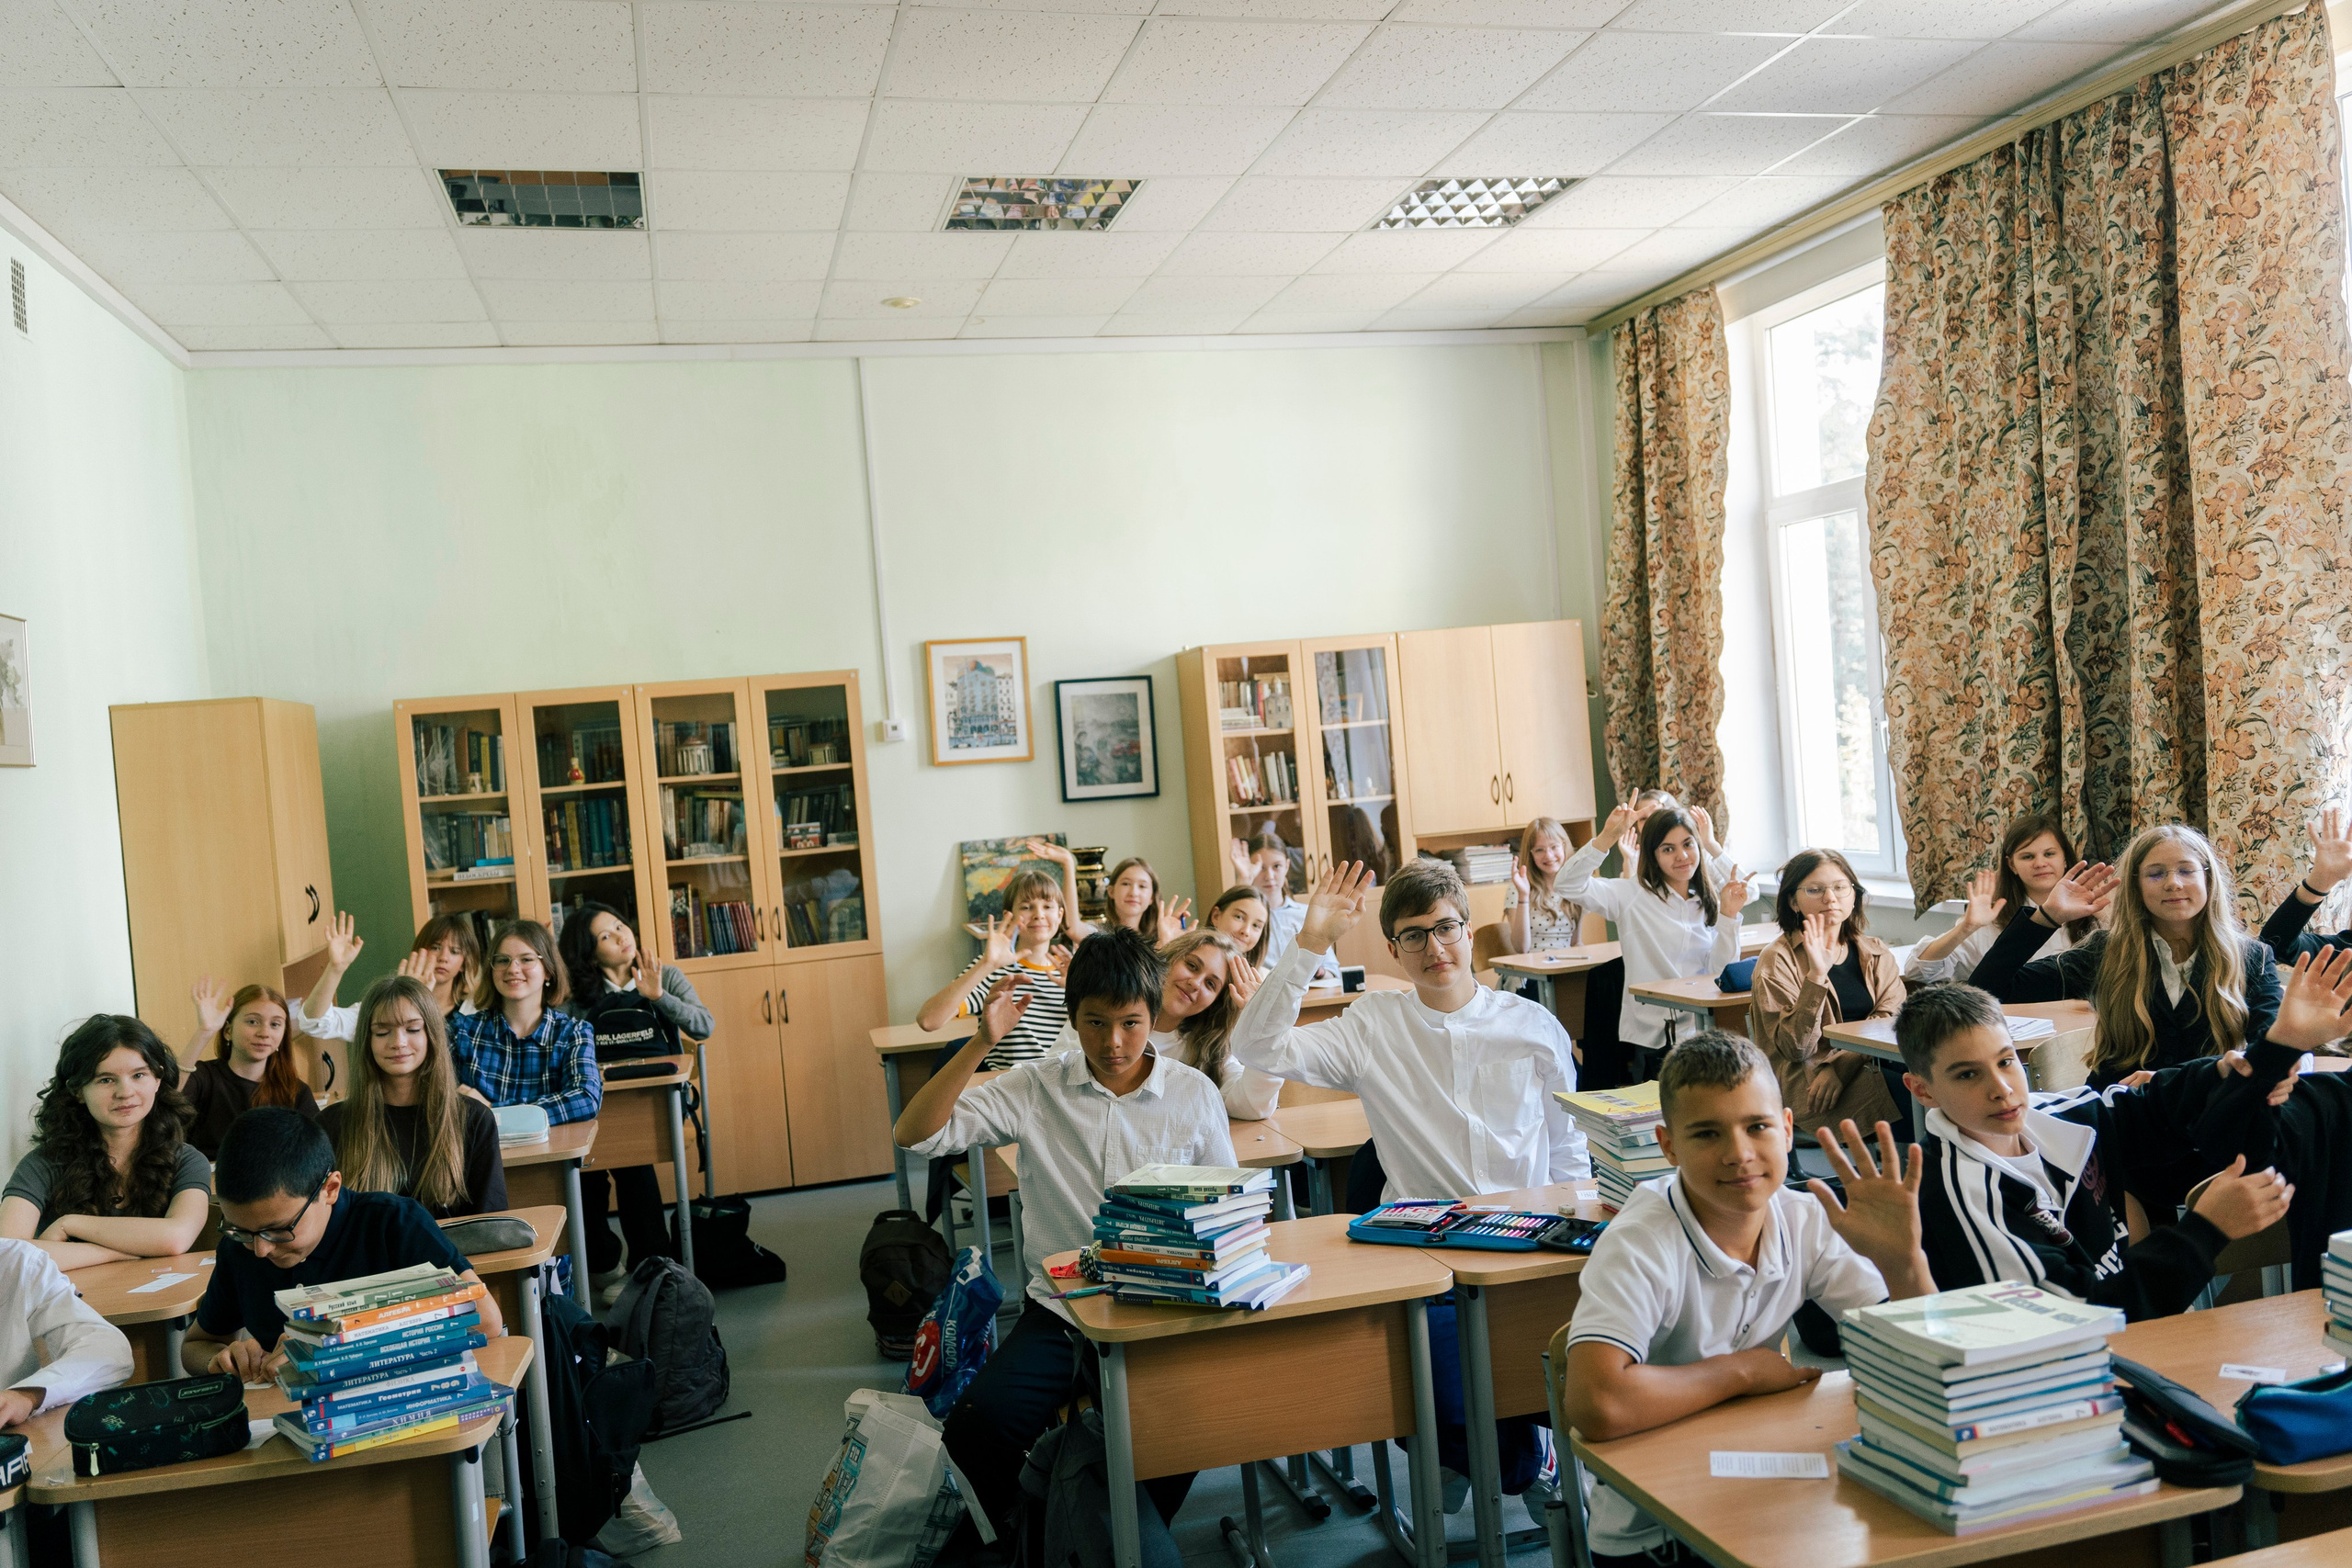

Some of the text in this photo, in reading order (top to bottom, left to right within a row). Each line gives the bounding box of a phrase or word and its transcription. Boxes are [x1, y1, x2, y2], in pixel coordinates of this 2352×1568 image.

[612, 1027, 653, 1041] LAGERFELD
[1155, 1258, 1182, 1266] АЛГЕБРА
[328, 1302, 345, 1311] Русский
[378, 1305, 412, 1319] АЛГЕБРА
[354, 1325, 390, 1338] МАТЕМАТИКА
[399, 1317, 423, 1327] АЛГЕБРА
[401, 1327, 424, 1338] ИСТОРИЯ
[424, 1324, 445, 1334] РОССИИ
[379, 1341, 408, 1353] ВСЕОБЩАЯ
[408, 1336, 431, 1348] ИСТОРИЯ
[368, 1352, 415, 1369] ЛИТЕРАТУРА
[342, 1371, 389, 1388] ЛИТЕРАТУРА
[386, 1376, 415, 1387] ФИЗИКА
[337, 1399, 372, 1410] МАТЕМАТИКА
[378, 1388, 422, 1402] Геометрия
[405, 1394, 452, 1410] ИНФОРМАТИКА
[392, 1410, 432, 1426] ХИМИЯ
